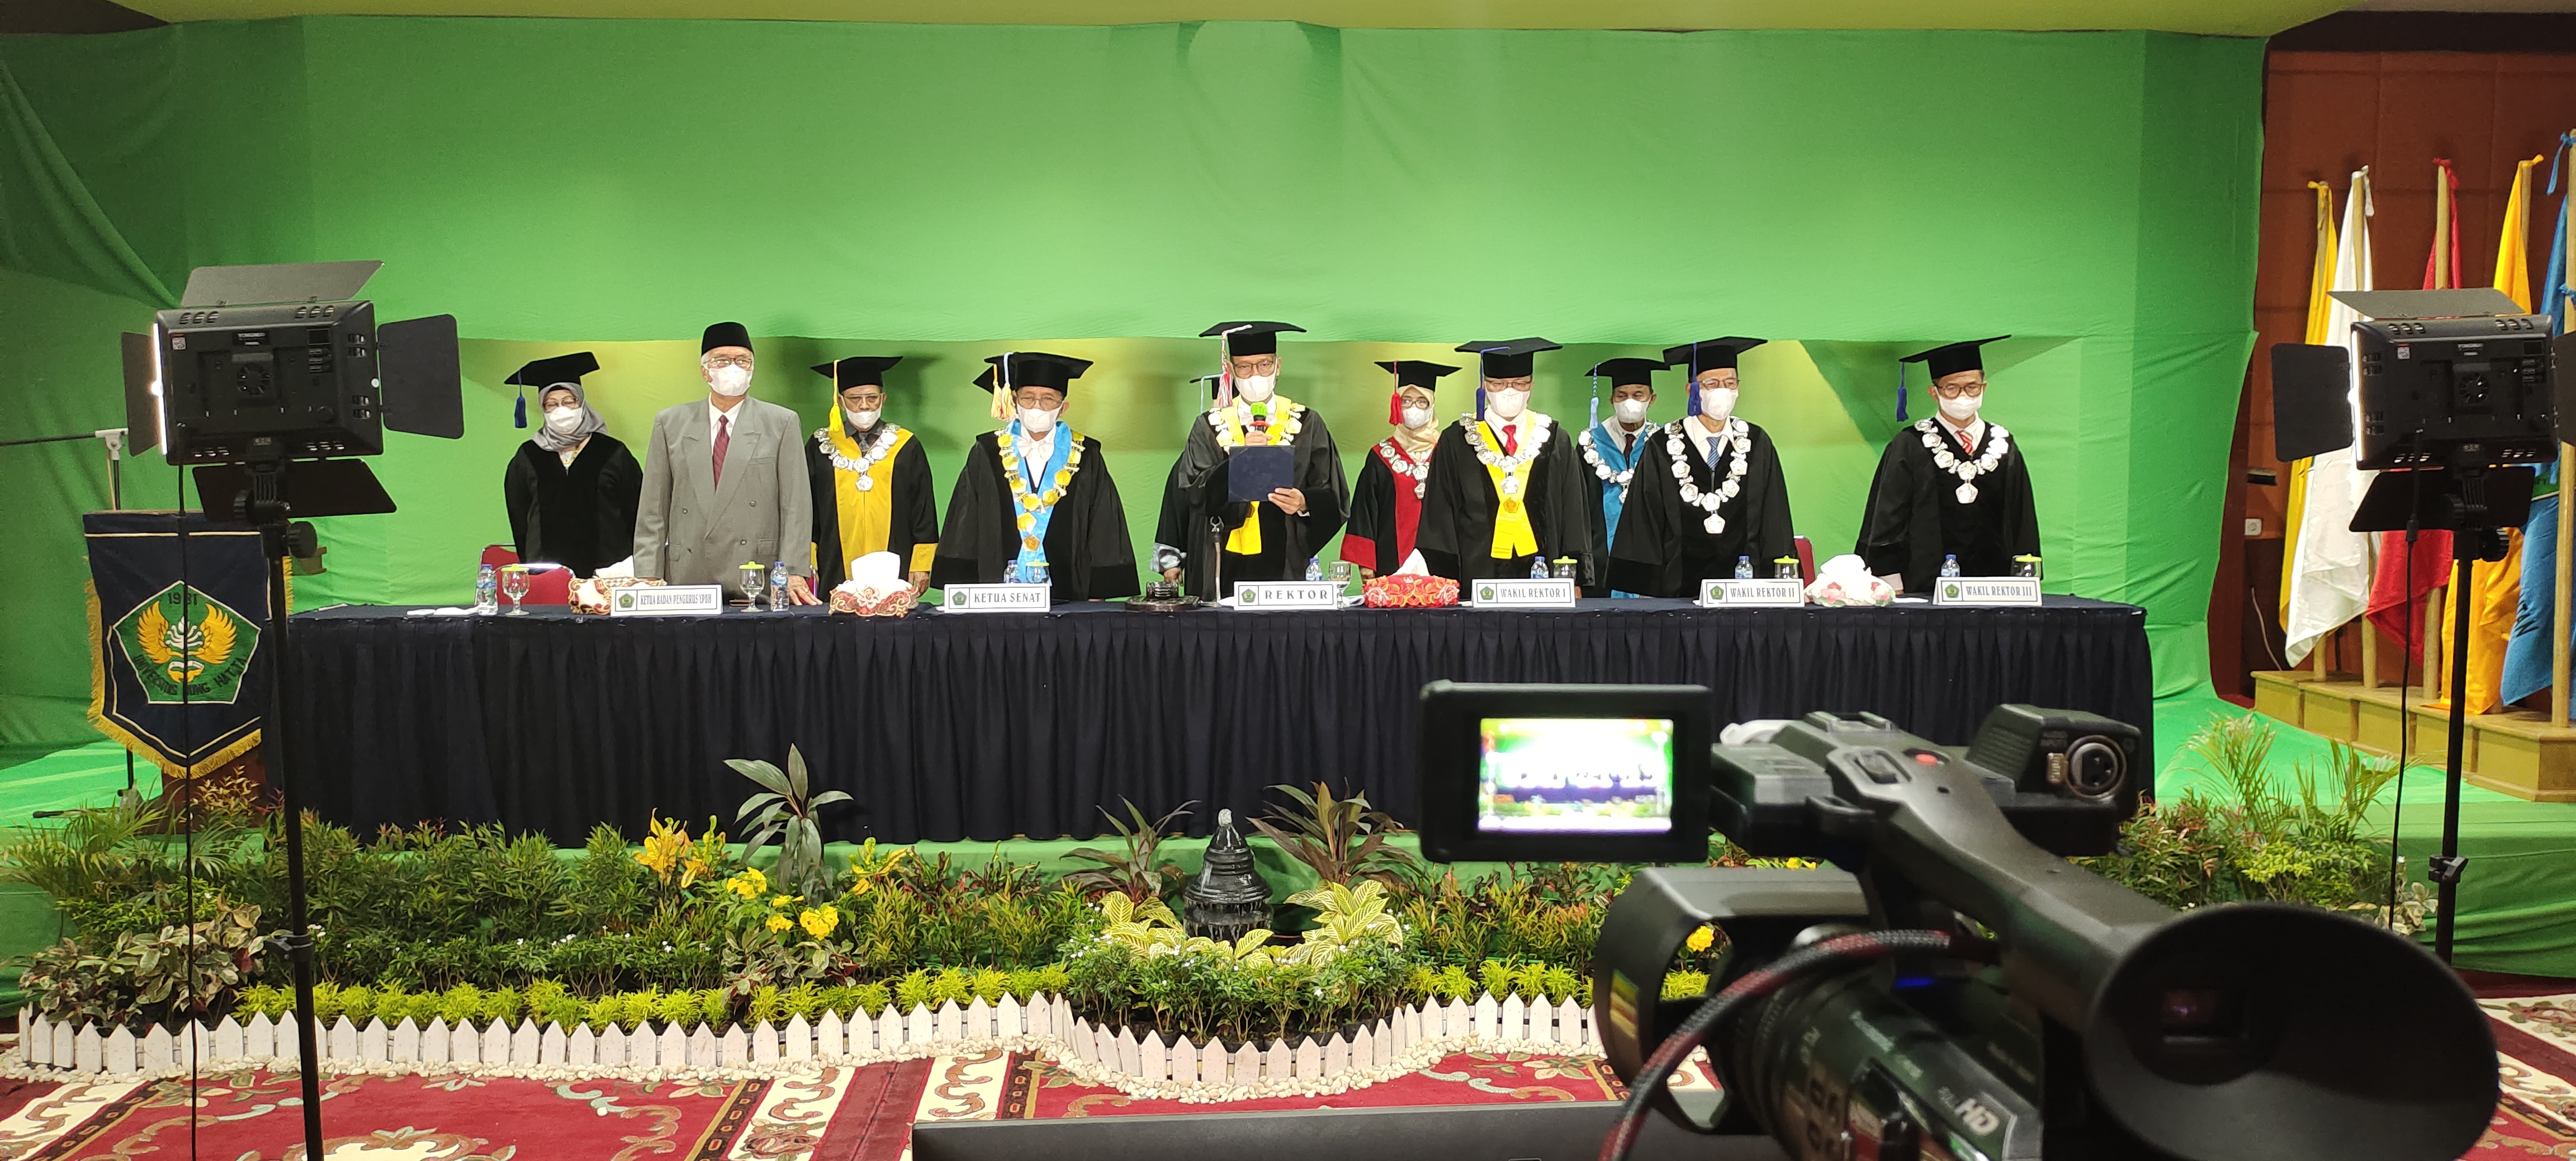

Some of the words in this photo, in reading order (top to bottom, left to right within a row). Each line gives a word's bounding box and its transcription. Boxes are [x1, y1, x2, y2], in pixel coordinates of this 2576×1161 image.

[1265, 590, 1328, 600] REKTOR
[1500, 588, 1526, 598] WAKIL
[1528, 588, 1561, 598] REKTOR
[1562, 588, 1566, 597] I
[1730, 587, 1755, 597] WAKIL
[1756, 587, 1787, 597] REKTOR
[1788, 587, 1794, 597] II
[1966, 586, 1990, 596] WAKIL
[1991, 586, 2020, 596] REKTOR
[2023, 586, 2032, 596] III
[640, 595, 656, 605] KETUA
[656, 594, 672, 605] BADAN
[673, 594, 698, 605] PENGURUS
[974, 593, 1007, 603] KETUA
[1010, 592, 1041, 602] SENAT
[184, 682, 211, 695] UNG
[213, 657, 247, 687] HATTA
[1954, 1097, 2000, 1136] HD
